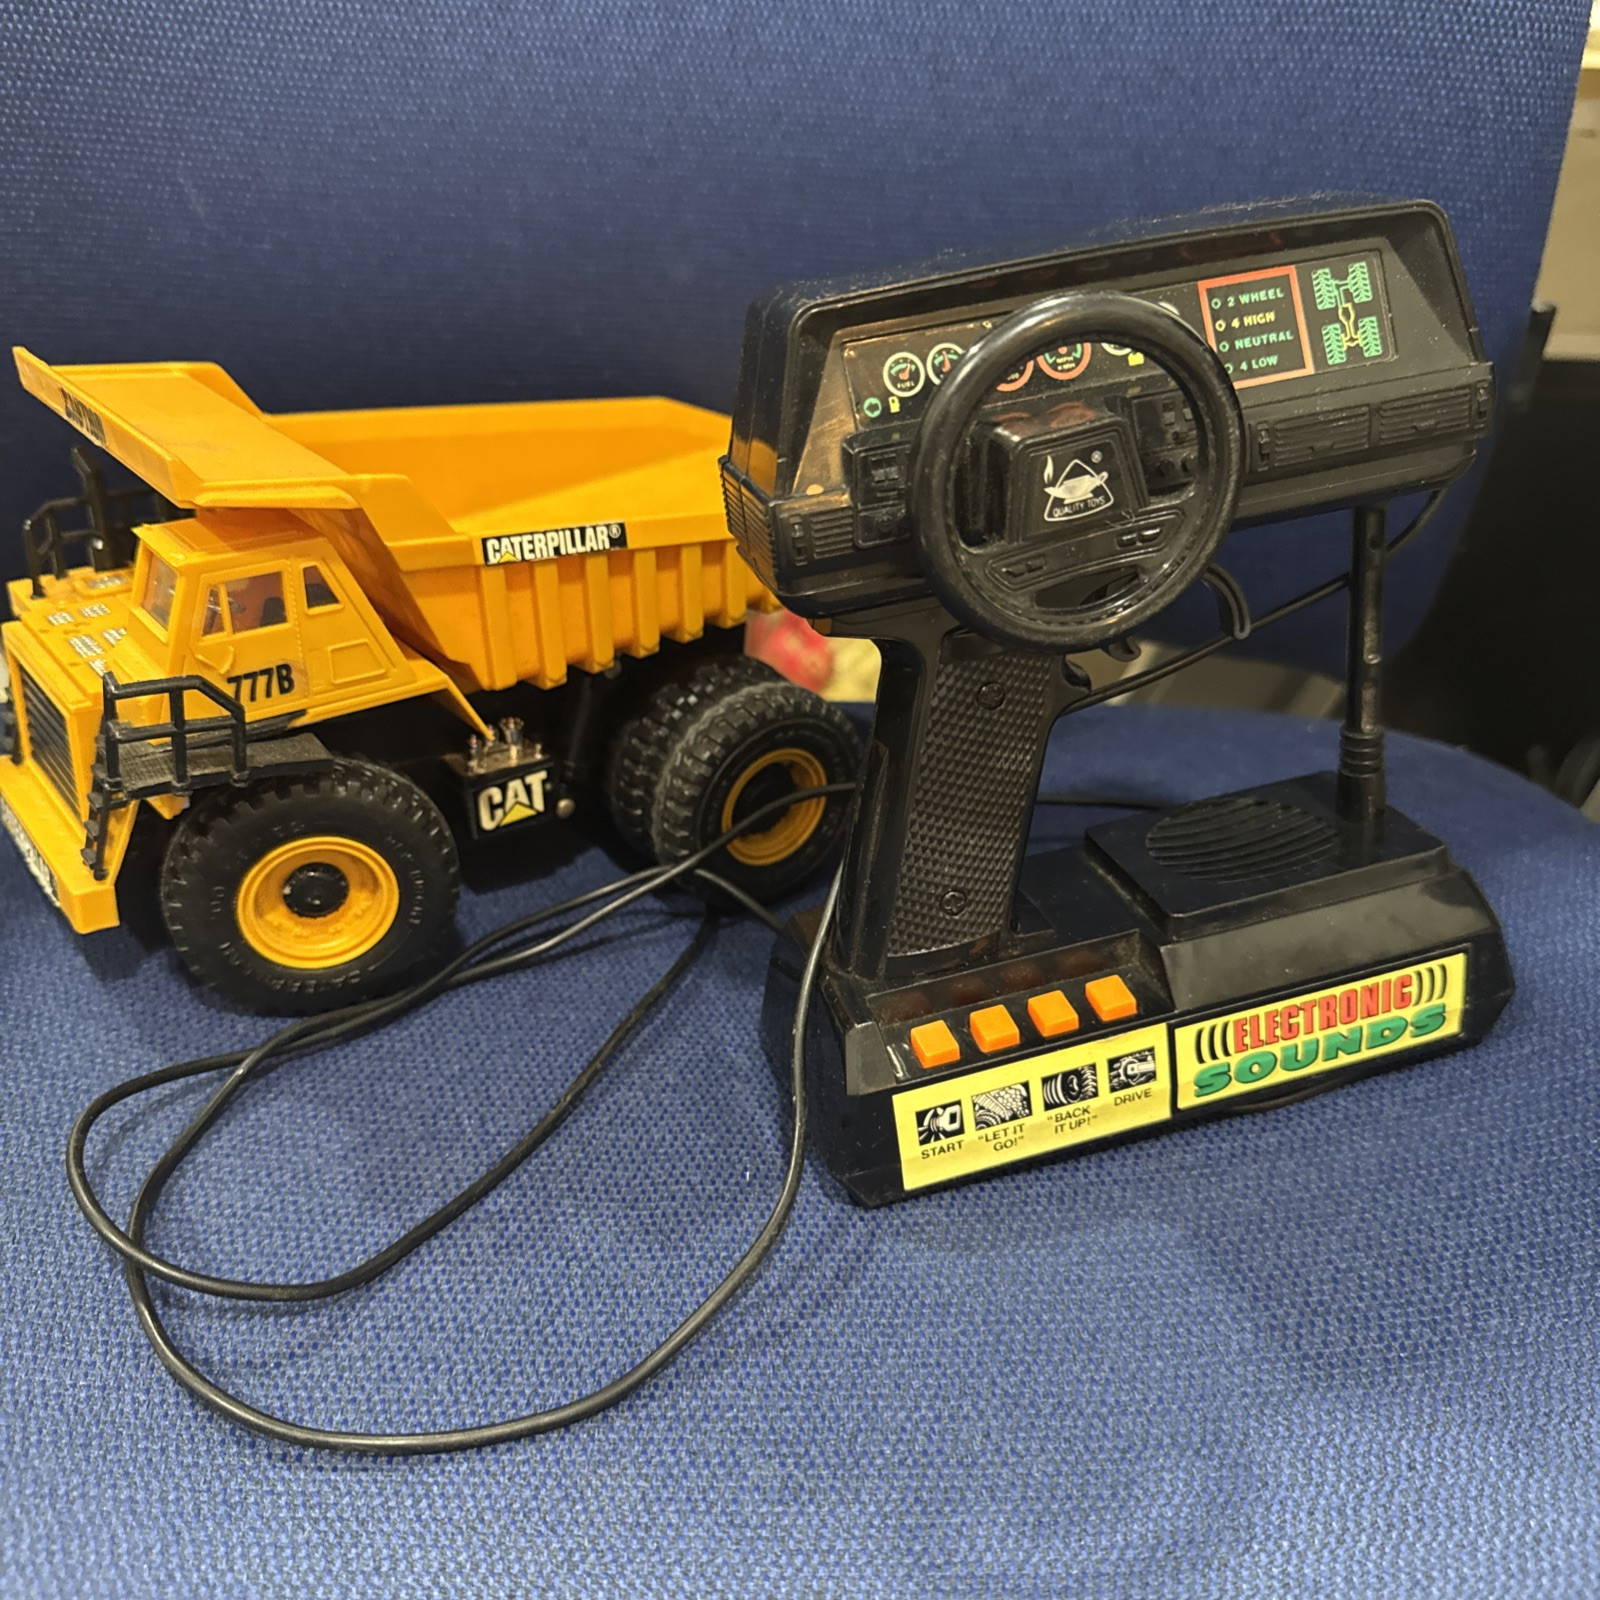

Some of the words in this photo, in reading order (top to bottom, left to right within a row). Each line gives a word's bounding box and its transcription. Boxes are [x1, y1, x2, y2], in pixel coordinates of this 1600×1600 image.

[1227, 296, 1235, 307] 2
[1238, 287, 1284, 304] WHEEL
[1231, 318, 1240, 329] 4
[1243, 311, 1276, 327] HIGH
[1234, 330, 1294, 350] NEUTRAL
[1239, 361, 1248, 371] 4
[1251, 354, 1279, 369] LOW
[897, 381, 915, 389] FUEL
[1052, 502, 1085, 518] QUALITY
[1087, 496, 1105, 508] TOYS
[227, 663, 295, 703] 777B
[478, 769, 548, 831] CAT
[1233, 974, 1412, 1053] ELECTRONIC
[1194, 1003, 1446, 1097] SOUNDS
[1113, 1087, 1152, 1107] DRIVE
[1013, 1123, 1026, 1135] IT
[1054, 1123, 1067, 1135] IT
[920, 1139, 964, 1160] START
